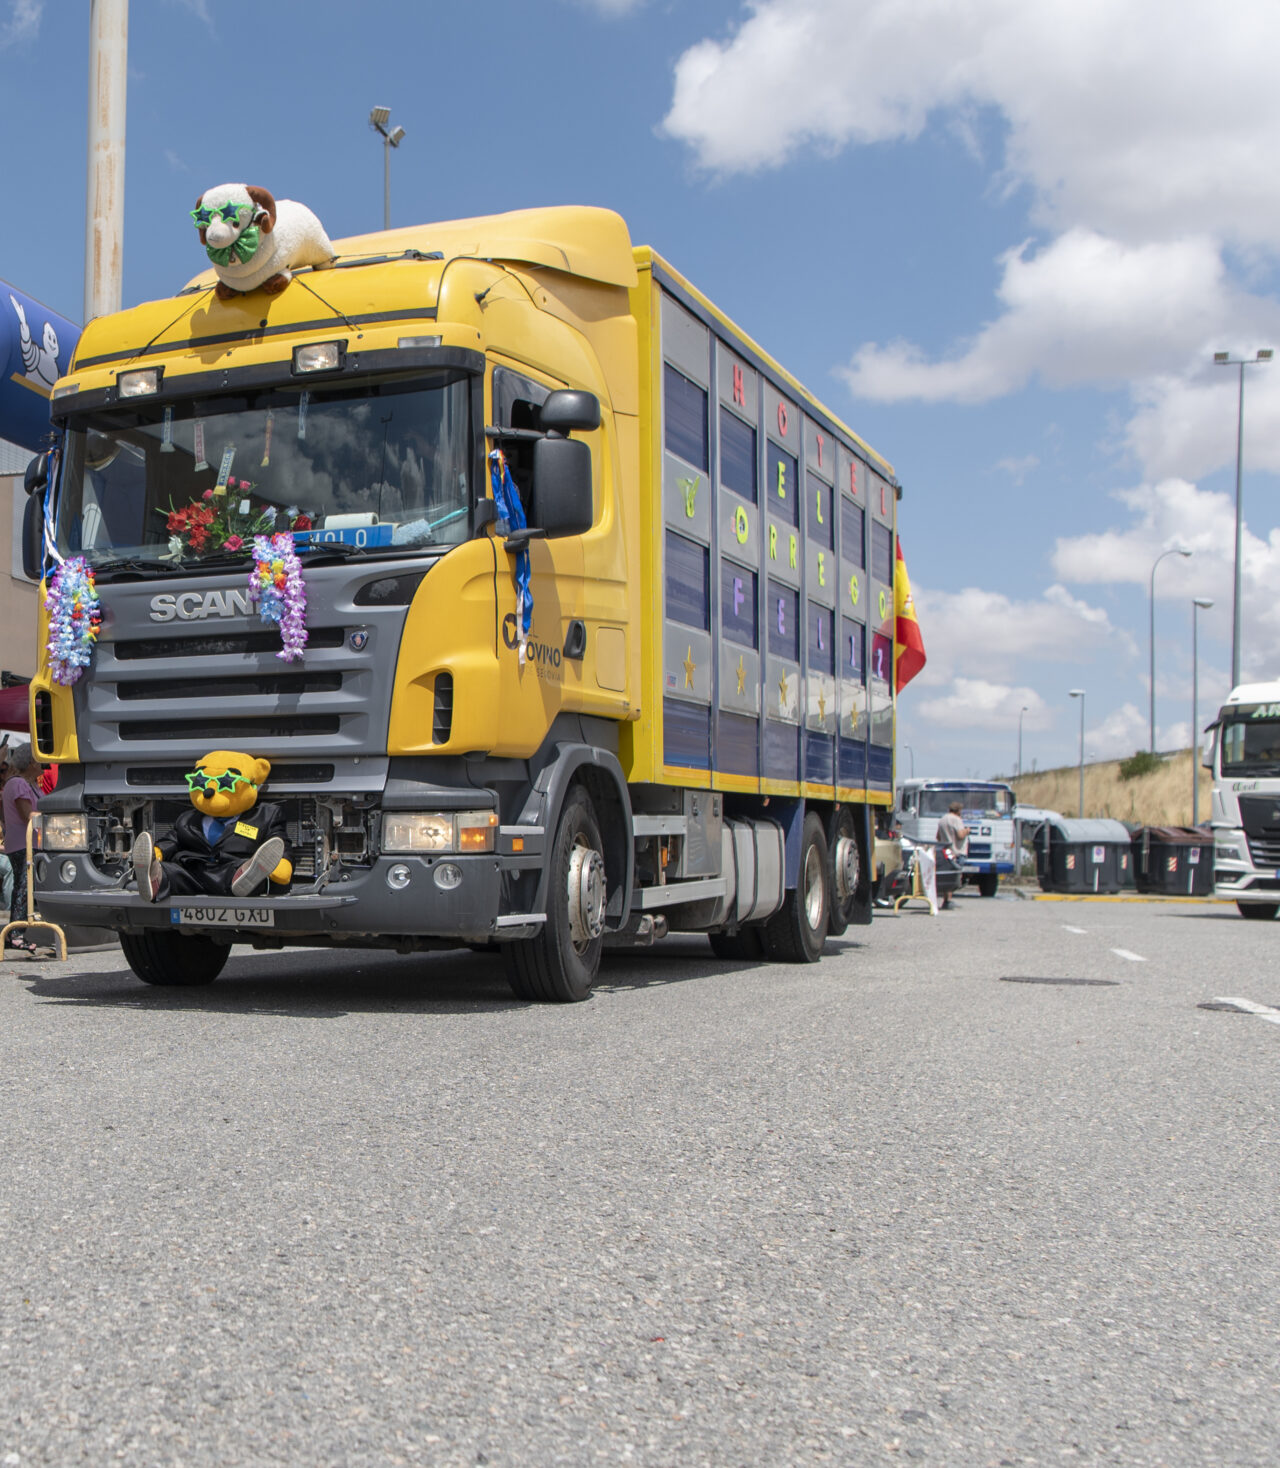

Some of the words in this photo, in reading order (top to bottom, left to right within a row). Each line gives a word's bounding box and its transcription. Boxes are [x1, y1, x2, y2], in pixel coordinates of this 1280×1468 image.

[732, 363, 888, 517] HOTEL
[149, 588, 260, 622] SCAN
[732, 577, 885, 679] FELIZ
[183, 908, 228, 923] 4802
